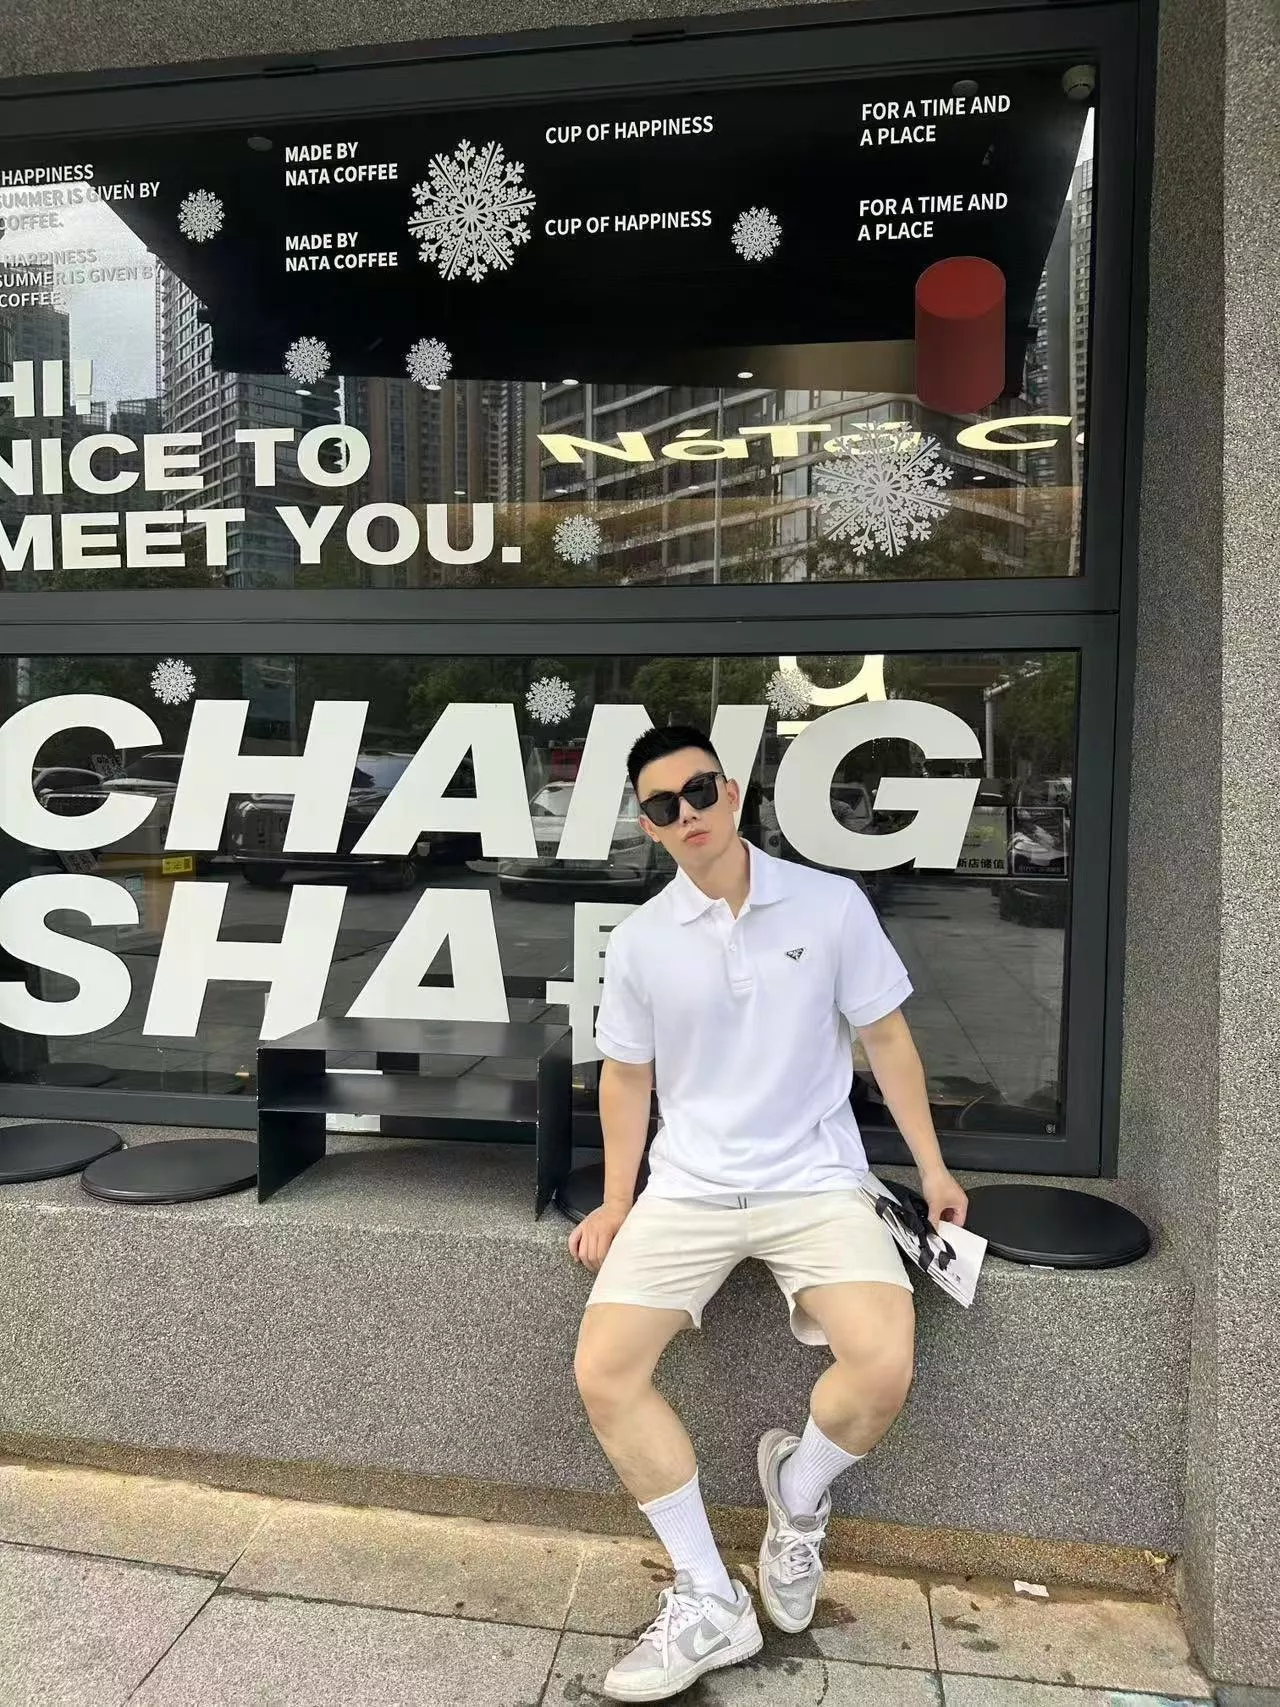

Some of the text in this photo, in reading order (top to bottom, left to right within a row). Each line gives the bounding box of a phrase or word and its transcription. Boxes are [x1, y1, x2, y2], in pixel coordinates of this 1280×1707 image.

[862, 95, 1011, 121] FOR A TIME AND
[545, 116, 714, 144] CUP OF HAPPINESS
[860, 125, 937, 146] A PLACE
[285, 141, 359, 163] MADE BY
[1, 163, 94, 186] HAPPINESS
[285, 163, 398, 187] NATA COFFEE
[0, 182, 160, 209] UMMER IS GIVEN BY
[859, 193, 1008, 217] FOR A TIME AND
[545, 210, 712, 236] CUP OF HAPPINESS
[857, 221, 934, 242] A PLACE
[285, 232, 359, 251] MADE BY
[3, 248, 98, 269] HAPPINESS
[285, 252, 398, 272] NATA COFFEE
[70, 269, 86, 285] IS
[88, 266, 138, 284] GIVEN
[143, 263, 162, 280] BY
[0, 424, 371, 496] NICE TO
[0, 502, 522, 572] MEET YOU.
[0, 693, 983, 872] CHANG
[0, 873, 511, 1041] SHA
